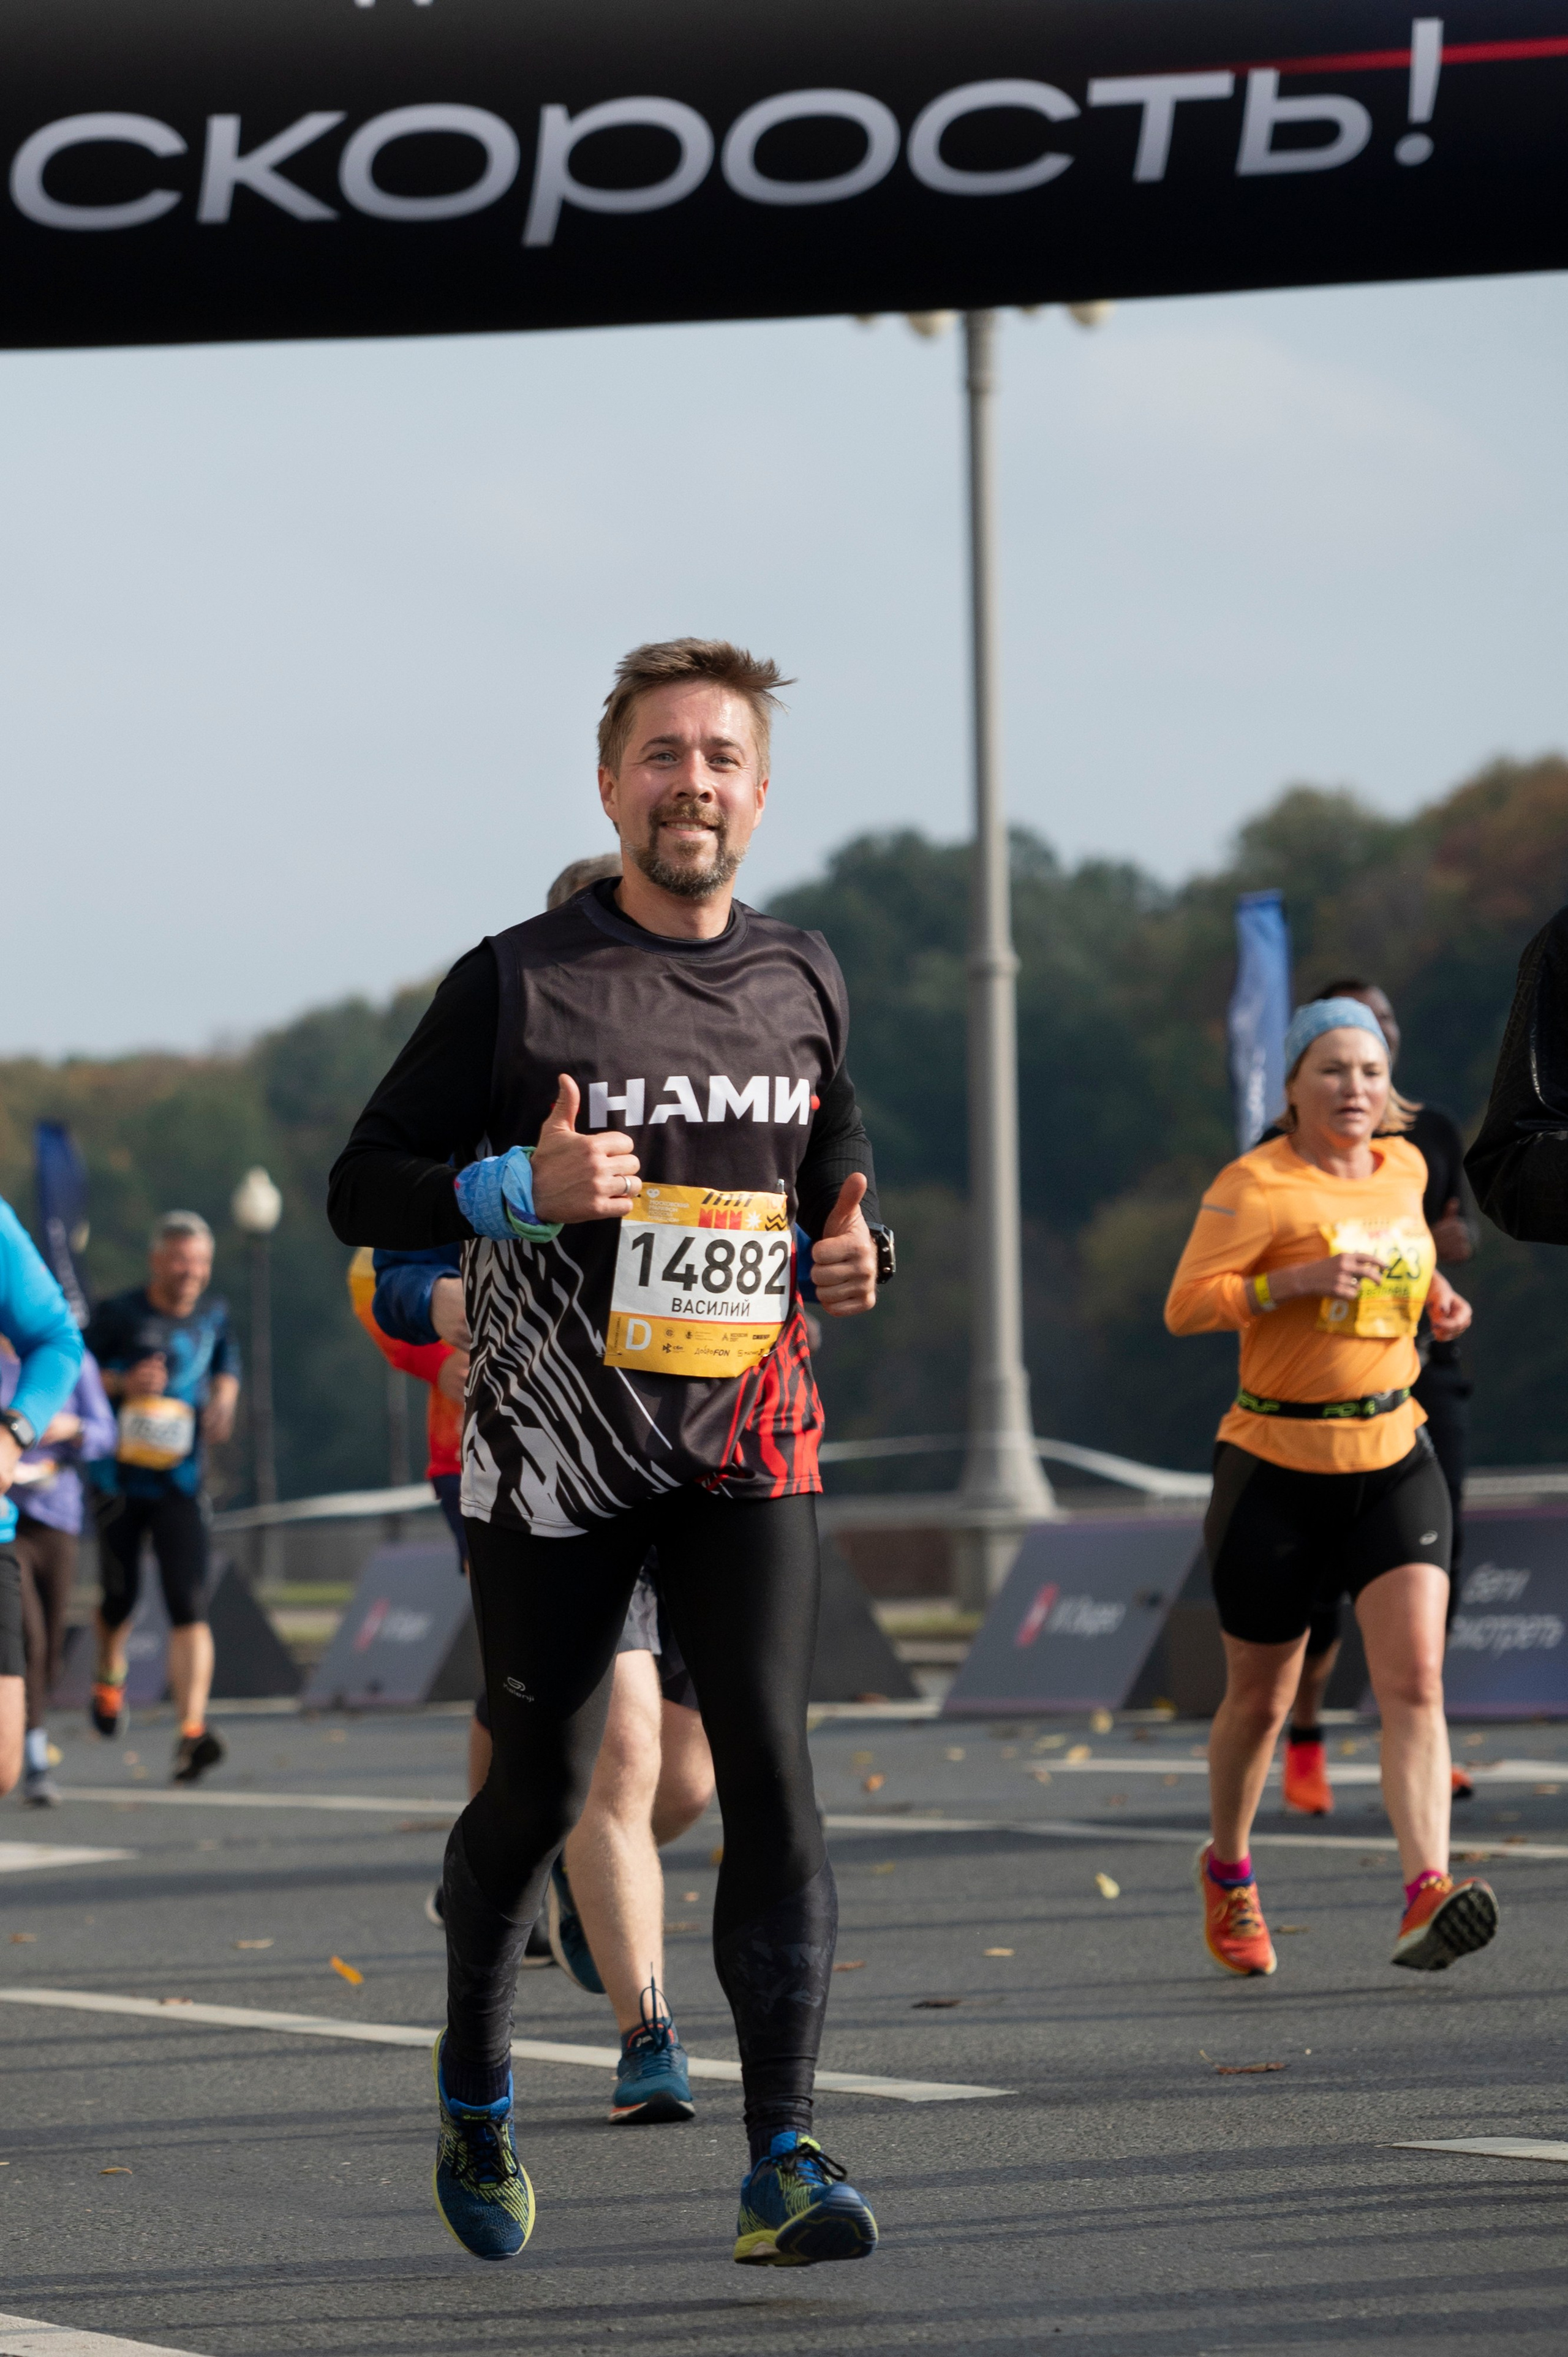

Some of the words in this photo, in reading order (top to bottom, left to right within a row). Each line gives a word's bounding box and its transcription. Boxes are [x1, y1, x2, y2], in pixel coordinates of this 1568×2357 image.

[9, 17, 1444, 249] скорость!
[589, 1075, 810, 1129] НАМИ
[631, 1232, 789, 1295] 14882
[625, 1317, 652, 1351] D
[671, 1297, 751, 1317] ВАСИЛИЙ
